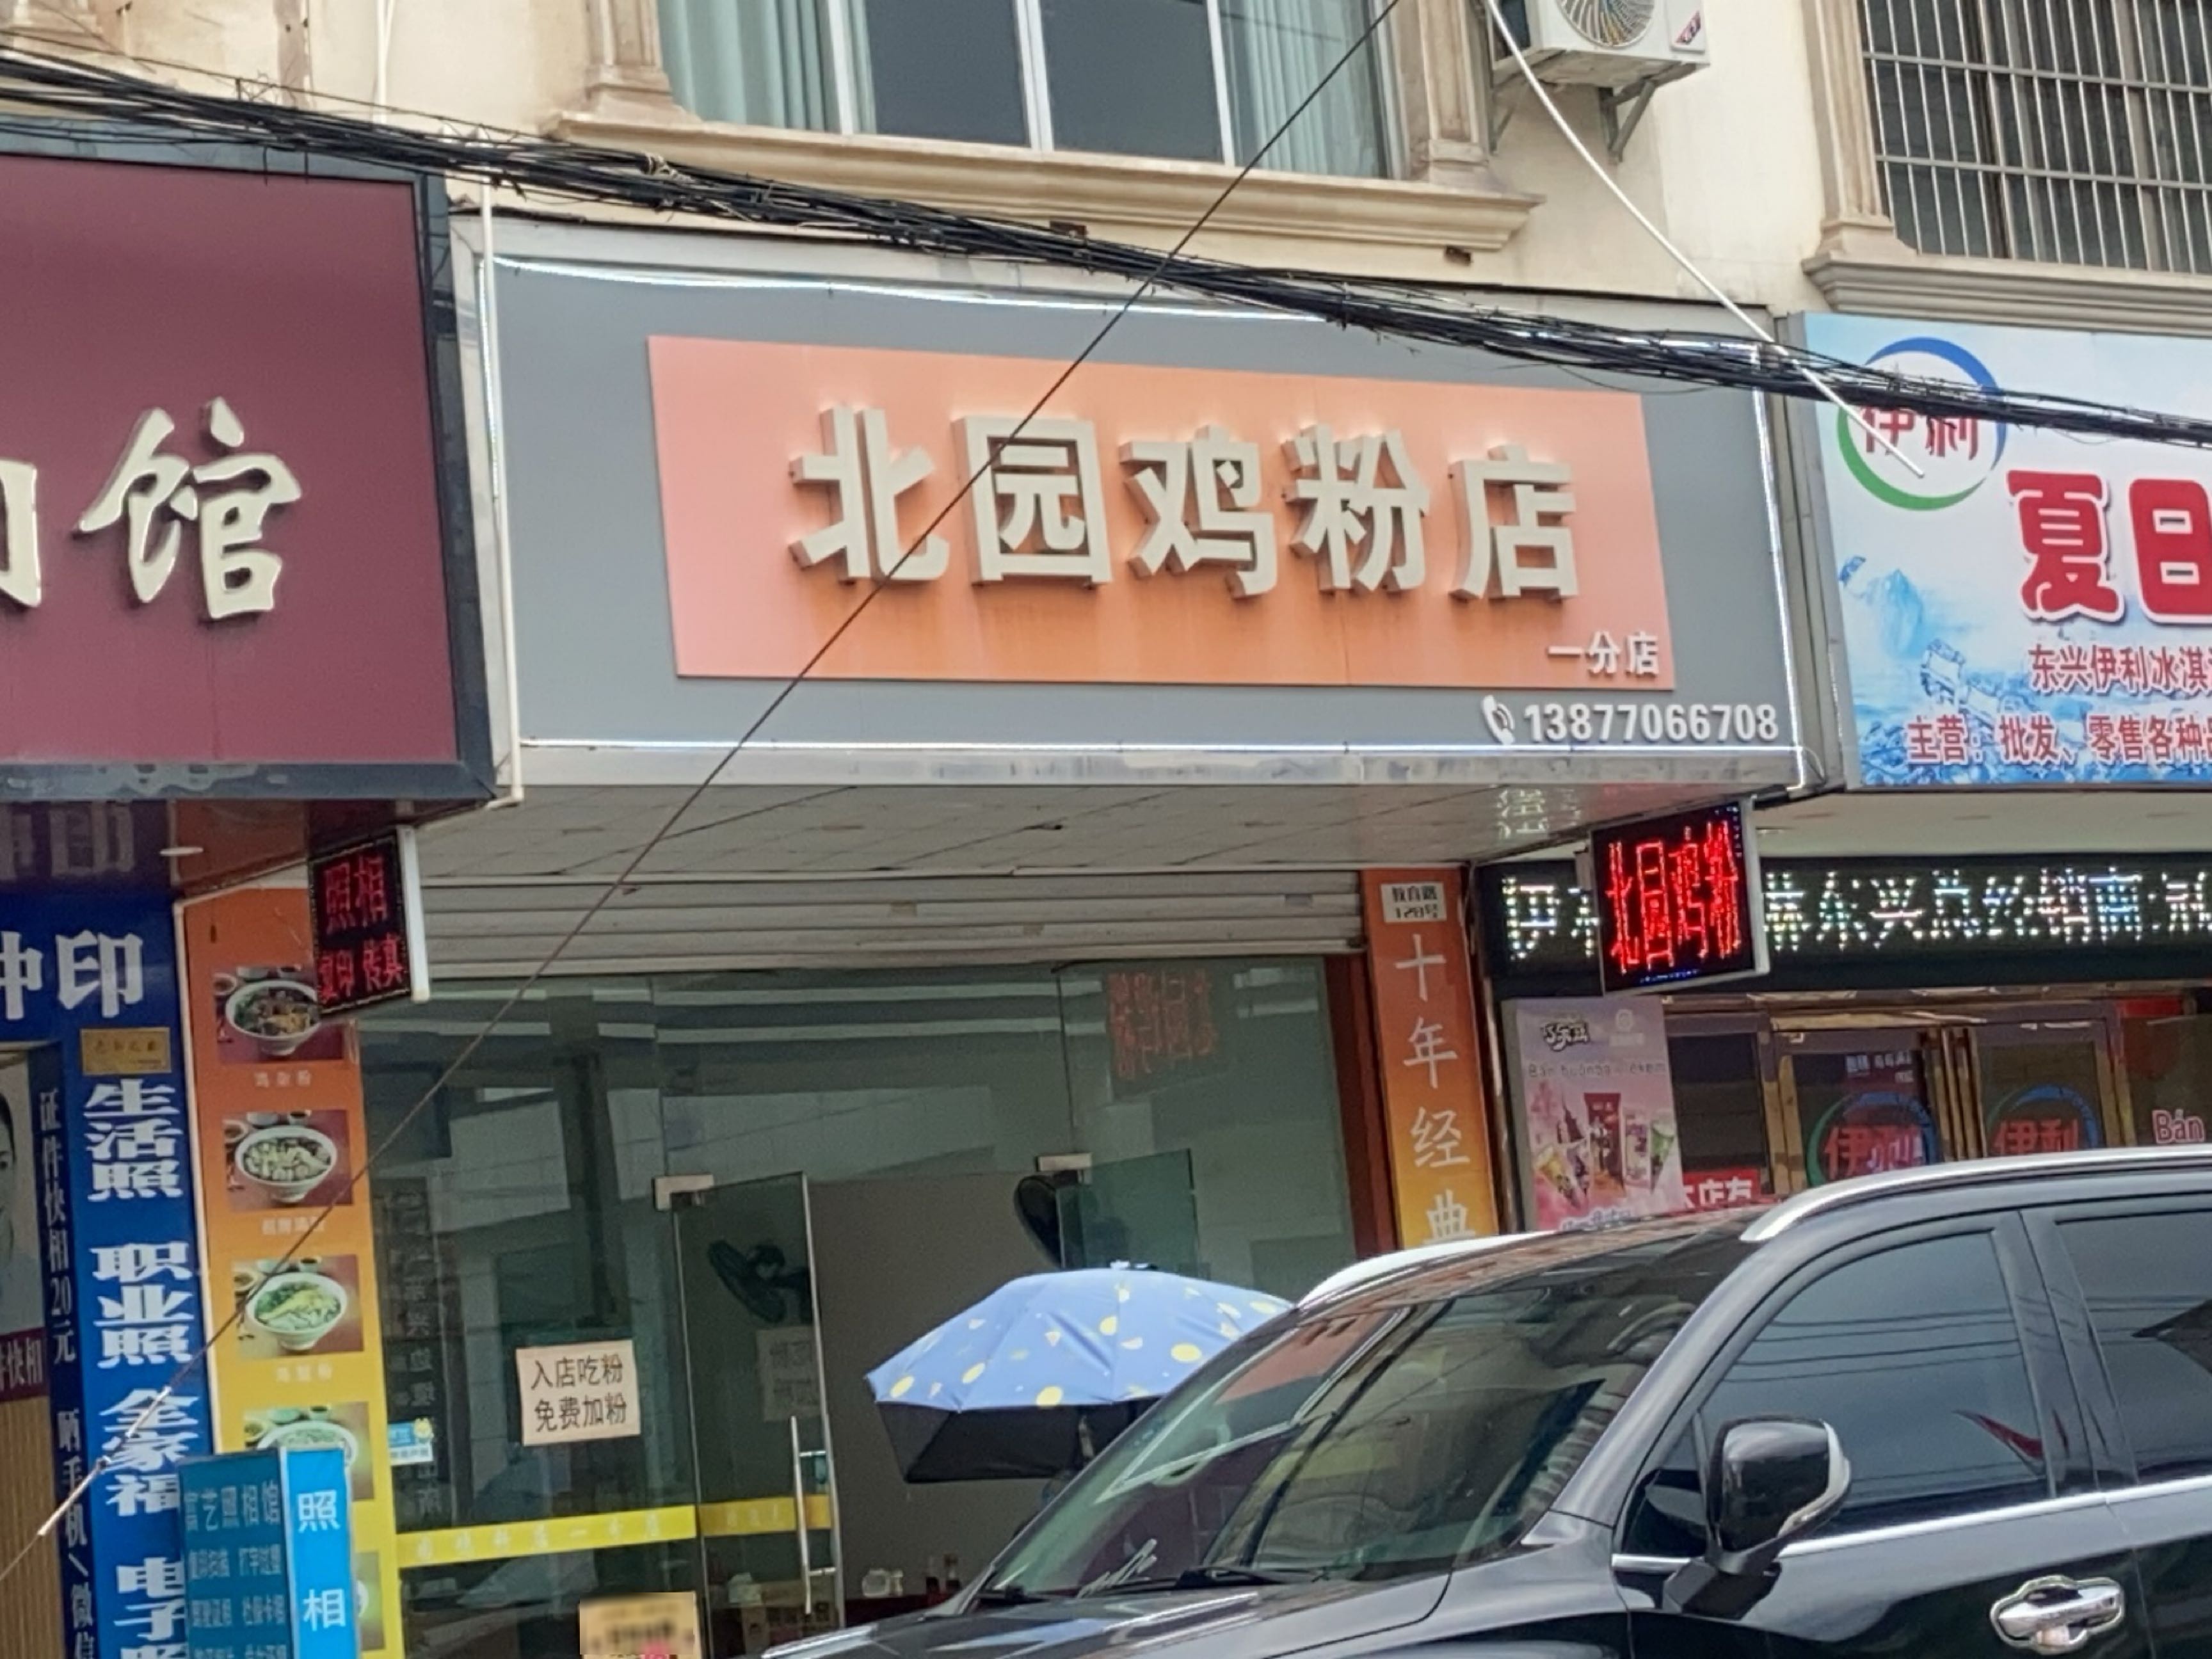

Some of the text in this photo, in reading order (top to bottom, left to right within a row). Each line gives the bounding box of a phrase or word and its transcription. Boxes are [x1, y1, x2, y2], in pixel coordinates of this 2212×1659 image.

[789, 405, 1578, 599] 北园鸡粉店
[2006, 468, 2212, 625] 夏日
[1548, 630, 1660, 676] 一分店
[2029, 643, 2212, 694] 东兴伊利冰淇
[1523, 703, 1779, 742] 13877066708
[1907, 713, 2212, 765] 主营：批发、零售各种
[325, 853, 388, 933] 照相
[1394, 933, 1476, 1244] 十年经典
[84, 1078, 184, 1201] 生活照
[89, 1241, 194, 1368] 职业照
[0, 1336, 44, 1393] 快相
[531, 1353, 623, 1390] 入店吃粉
[99, 1387, 200, 1517] 全家福
[534, 1392, 627, 1432] 免费加粉
[297, 1489, 347, 1631] 照相
